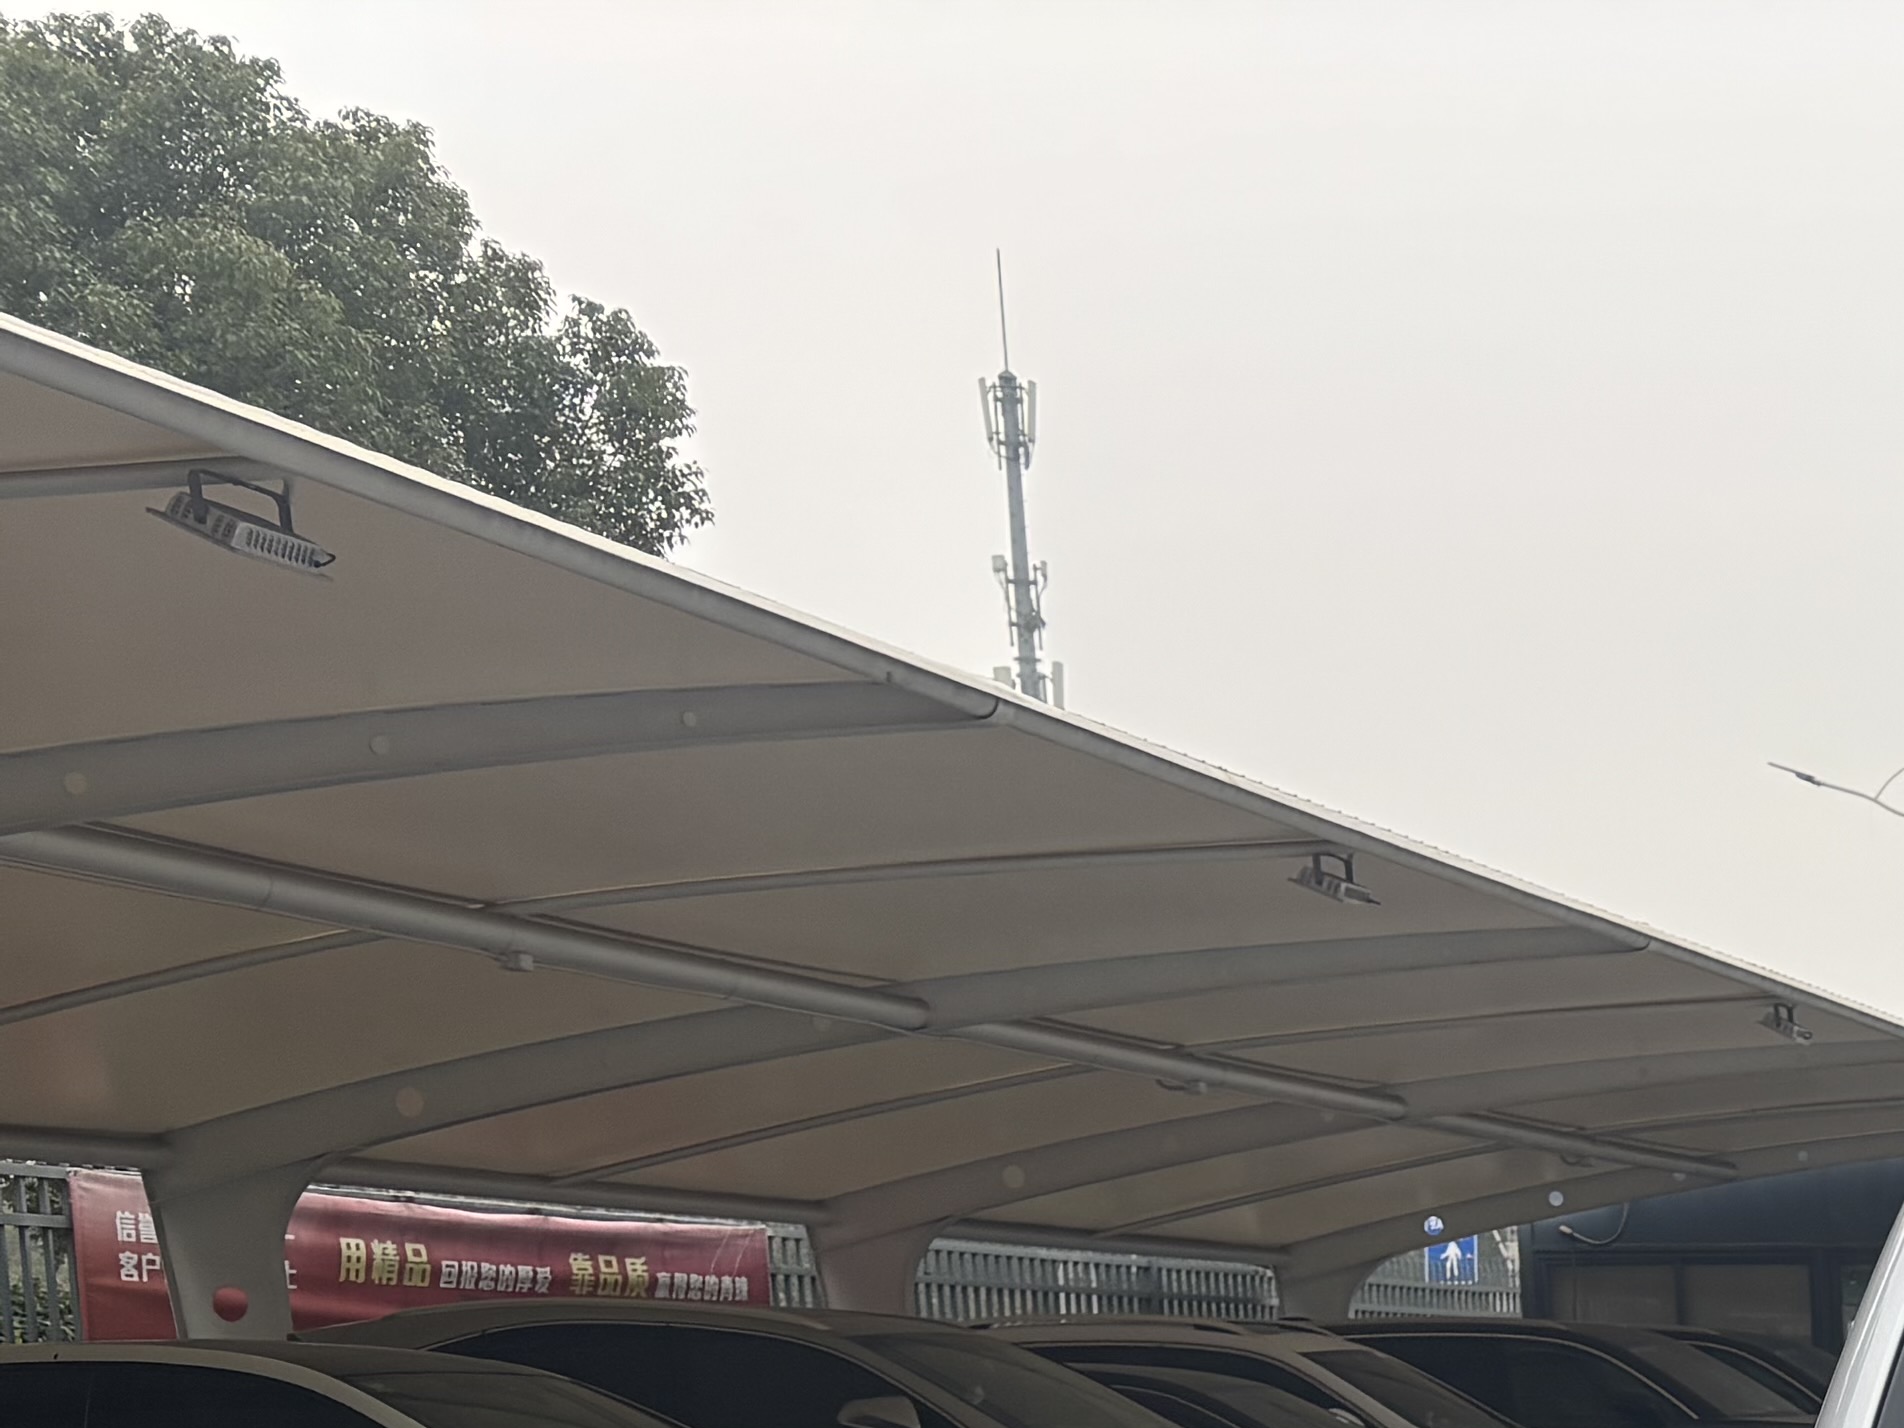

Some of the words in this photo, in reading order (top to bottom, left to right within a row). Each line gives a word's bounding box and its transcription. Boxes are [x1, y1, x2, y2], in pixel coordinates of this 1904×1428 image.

[339, 1237, 431, 1287] 用精品
[569, 1252, 649, 1297] 靠品质
